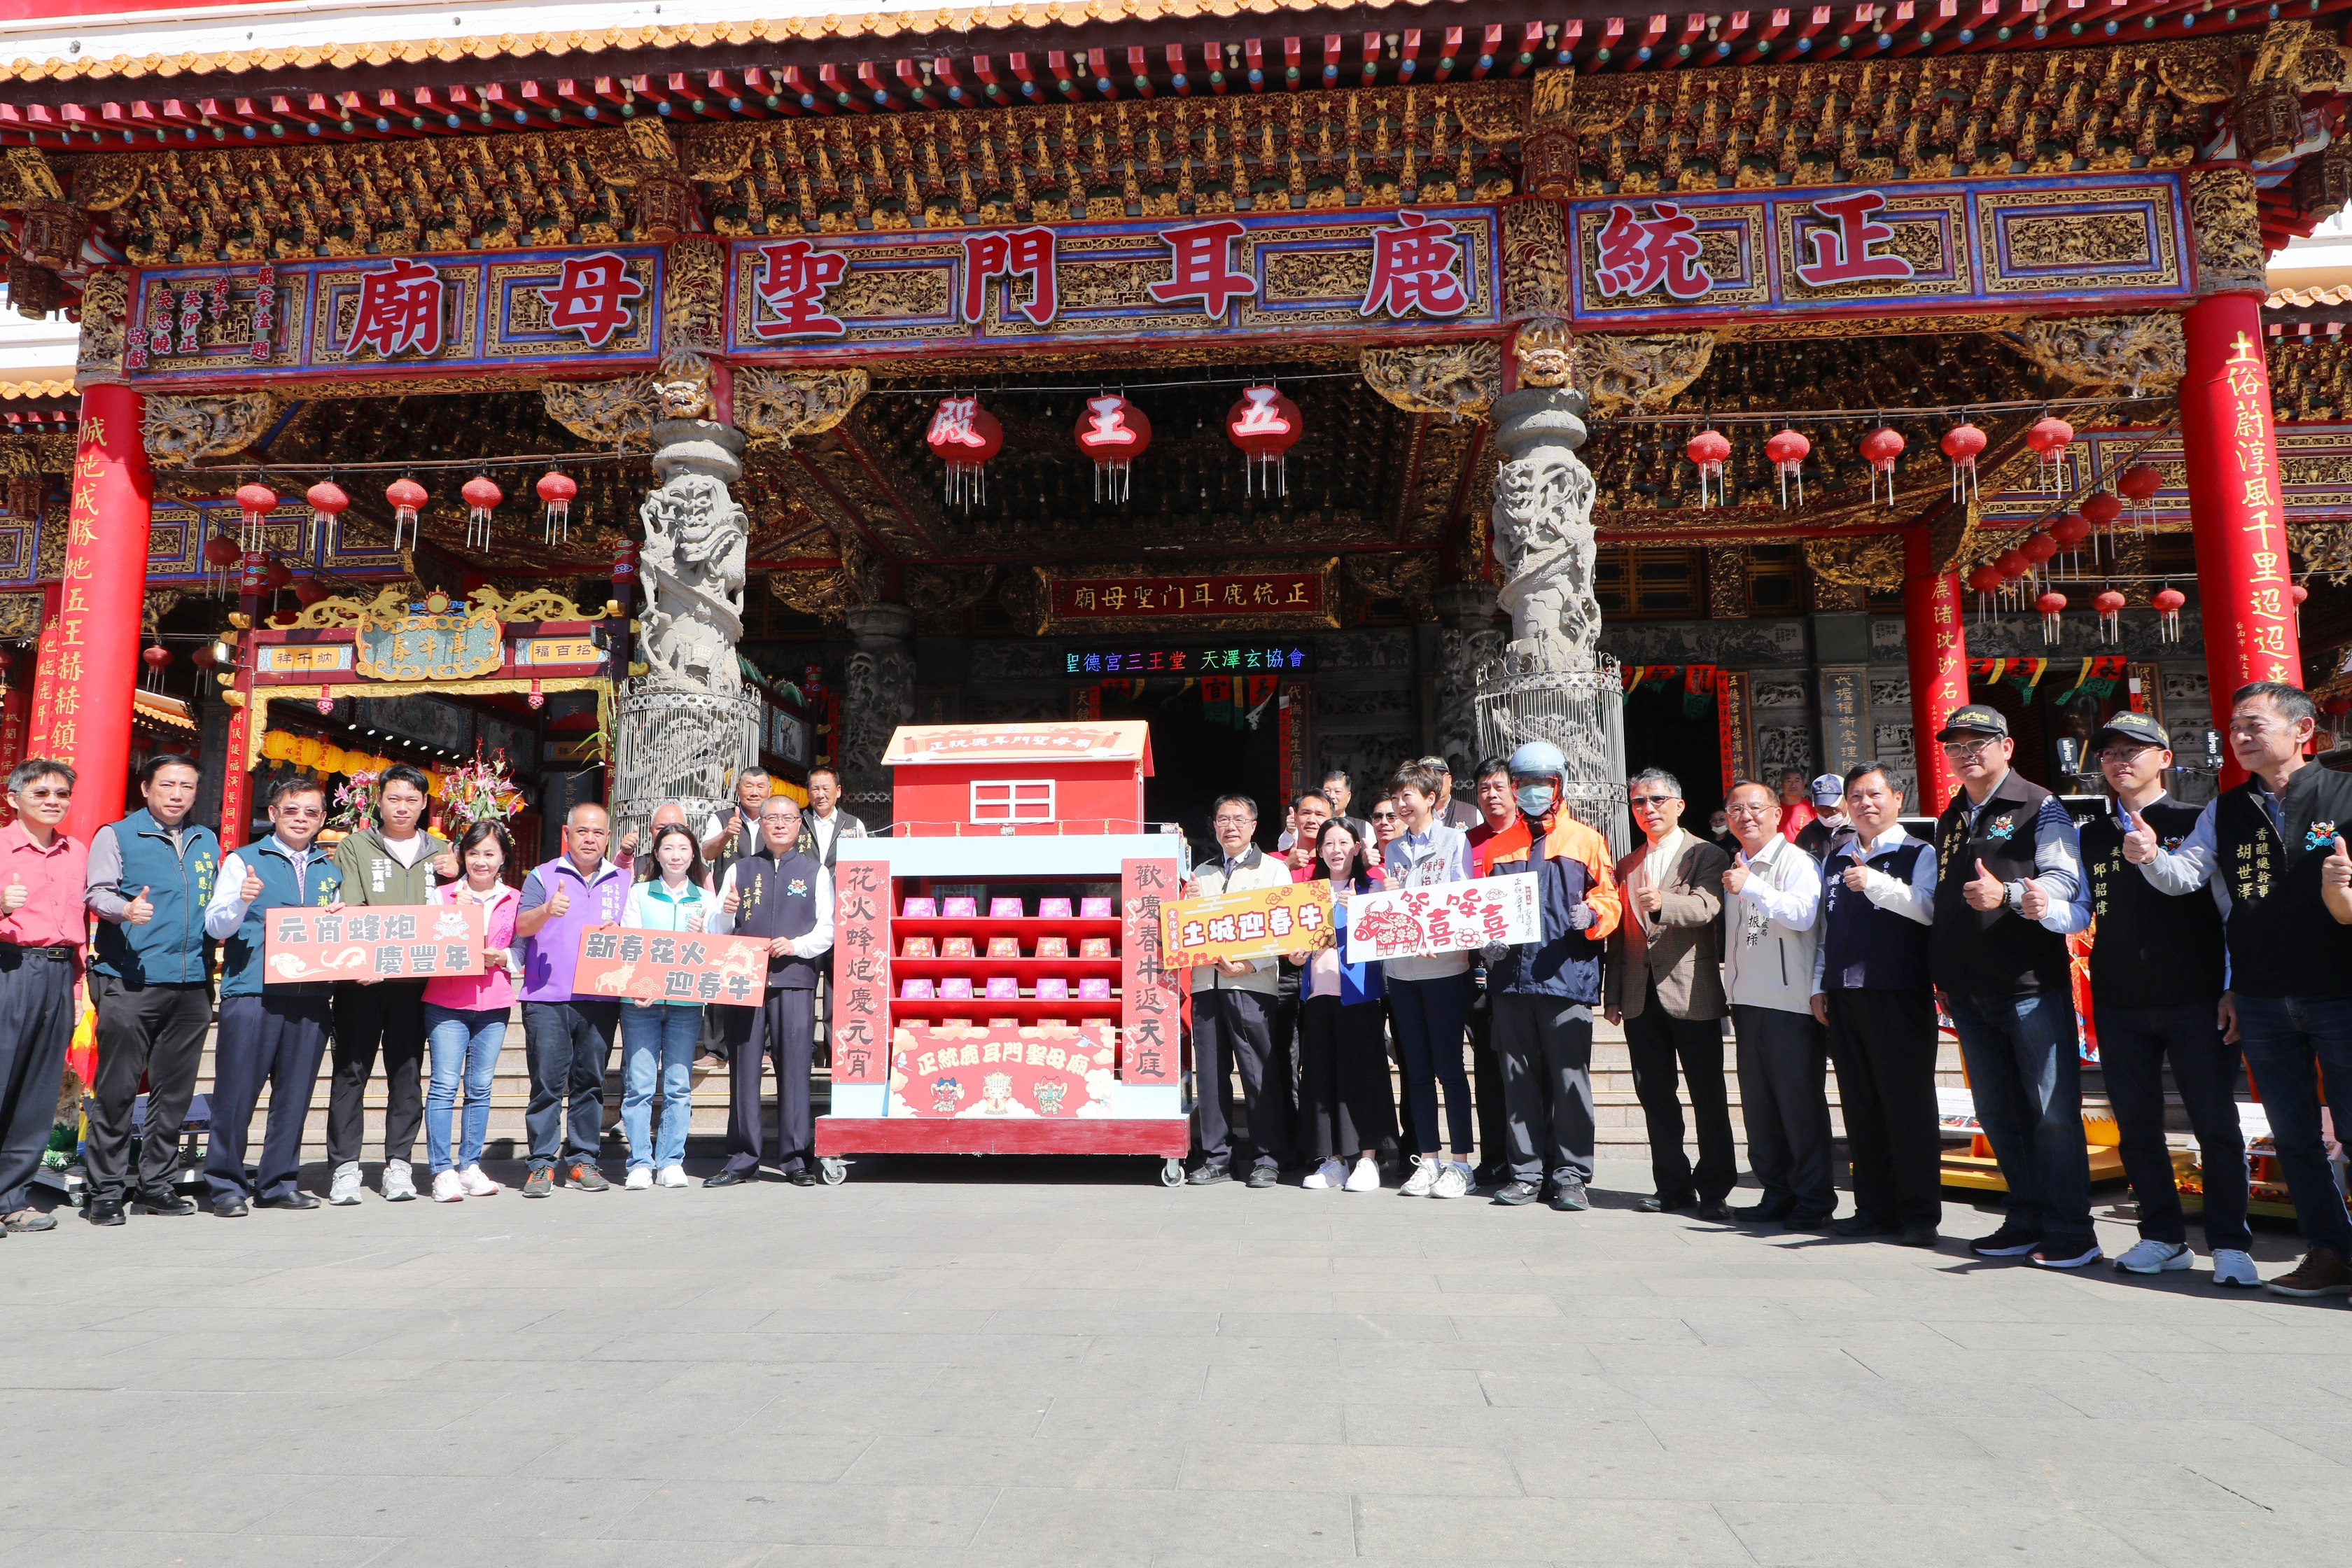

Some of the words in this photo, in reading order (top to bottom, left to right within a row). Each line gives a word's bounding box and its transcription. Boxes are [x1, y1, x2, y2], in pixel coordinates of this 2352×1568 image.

[210, 277, 229, 319] 弟子
[390, 633, 469, 662] 春牛亭
[928, 734, 1093, 753] 正統鹿耳門聖母廟
[2110, 846, 2121, 872] 委員
[2236, 843, 2253, 900] 胡世澤
[2255, 827, 2272, 898] 香醮總幹事
[2093, 862, 2108, 916] 邱韶偉
[277, 913, 417, 944] 元宵蜂炮
[1168, 909, 1180, 951] 文化資產
[1182, 902, 1324, 948] 土城迎春牛
[374, 944, 472, 974] 慶豐年
[585, 933, 707, 965] 新春花火
[664, 969, 753, 1001] 迎春牛
[846, 865, 876, 1079] 花火蜂炮慶元宵
[1135, 864, 1166, 1078] 歡慶春牛返天庭
[916, 1041, 1091, 1077] 正統鹿耳門聖母廟
